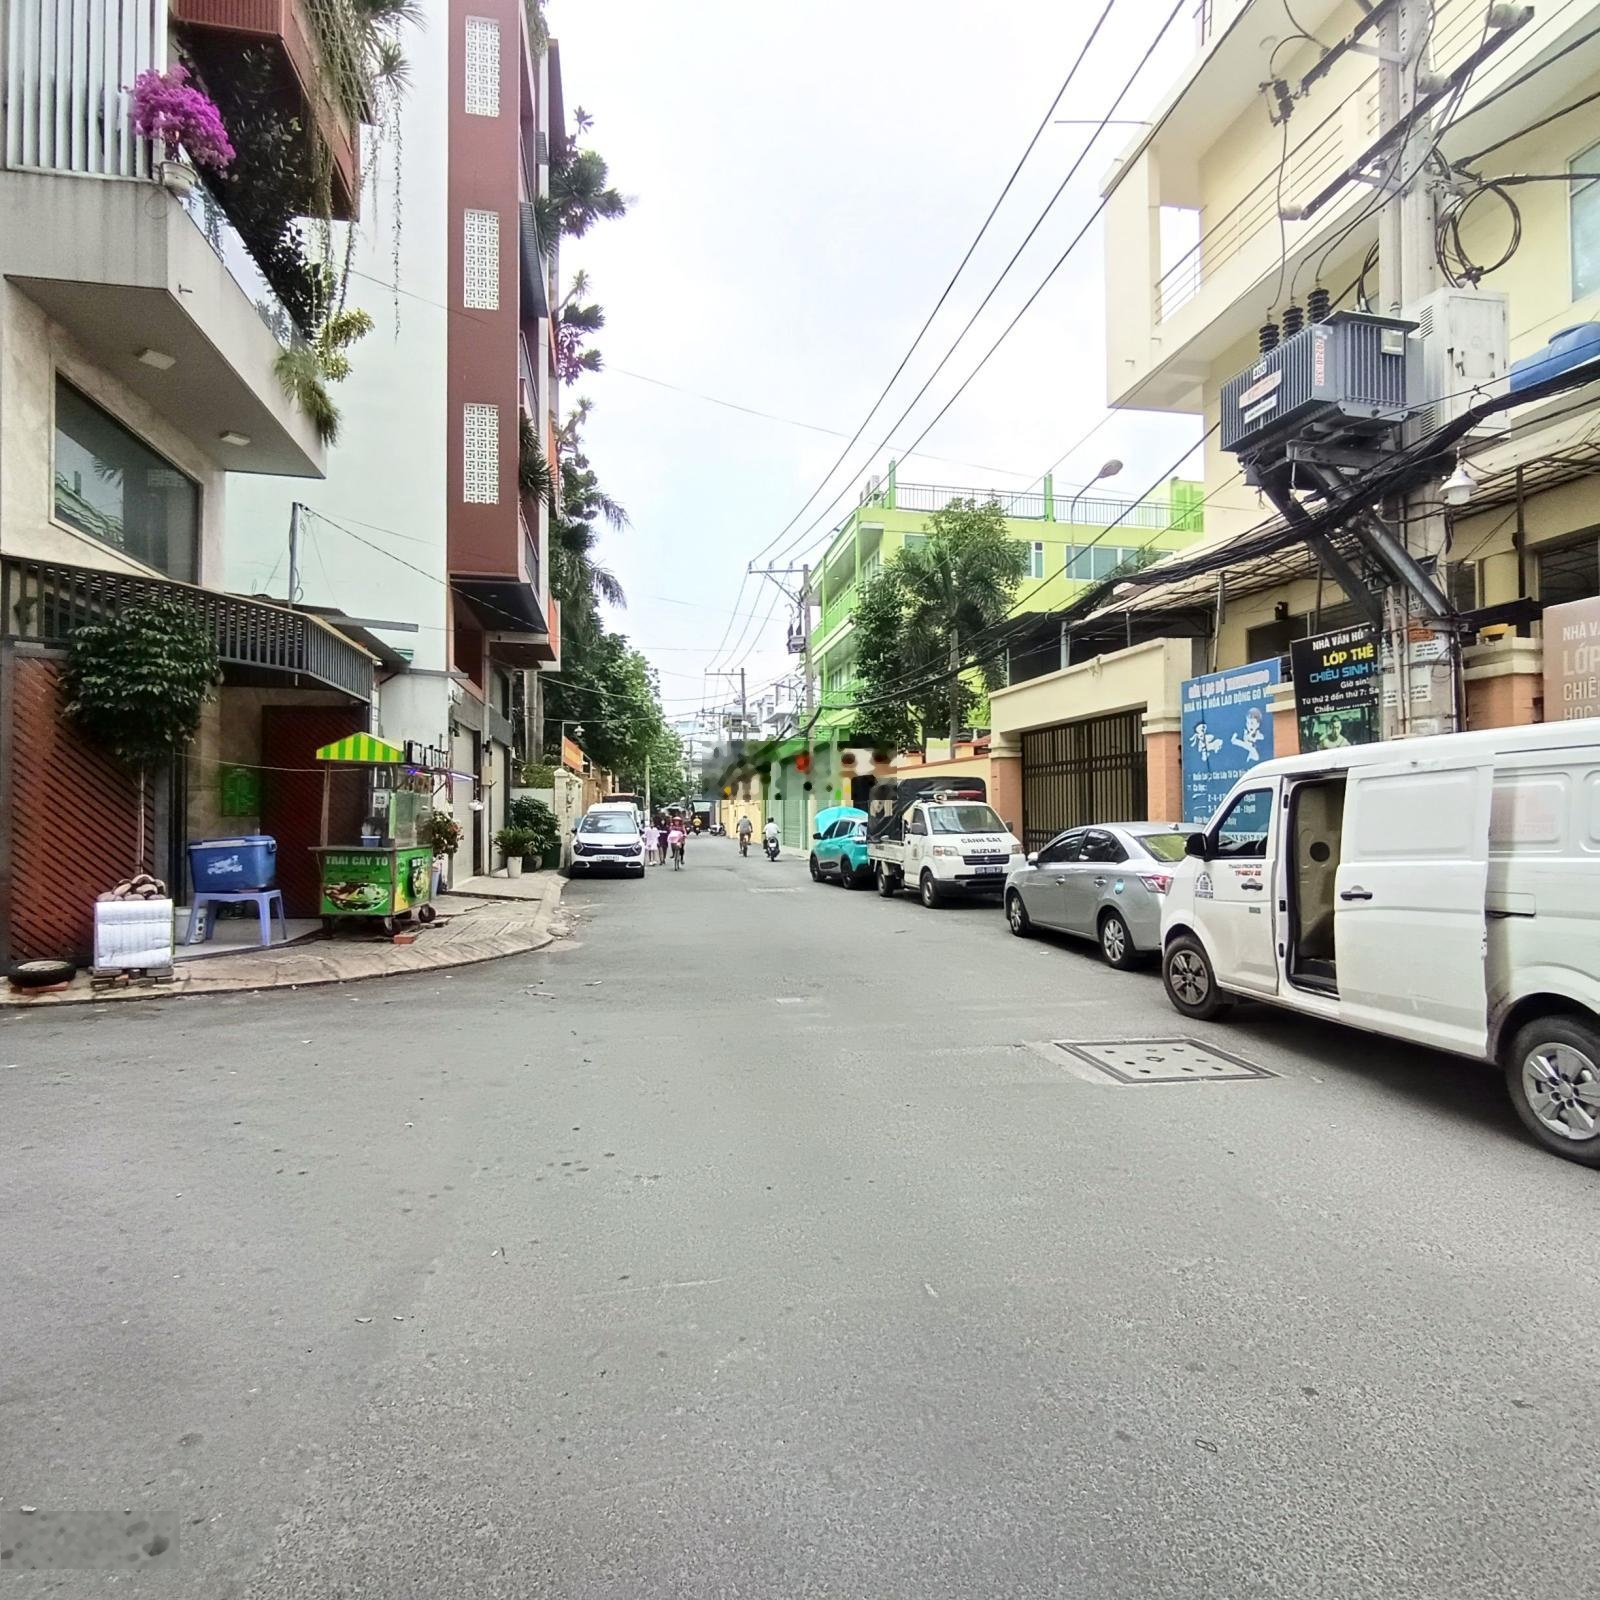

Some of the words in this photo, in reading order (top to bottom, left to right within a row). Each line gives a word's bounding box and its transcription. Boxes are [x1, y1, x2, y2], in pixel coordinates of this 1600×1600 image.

[1563, 621, 1586, 641] NHÀ
[1312, 637, 1330, 651] NHÀ
[1331, 633, 1350, 647] VĂN
[1322, 650, 1347, 667] LỚP
[1342, 662, 1368, 678] SINH
[1563, 676, 1600, 702] CHIÊ
[1221, 694, 1233, 706] LAO
[1325, 694, 1330, 702] 2
